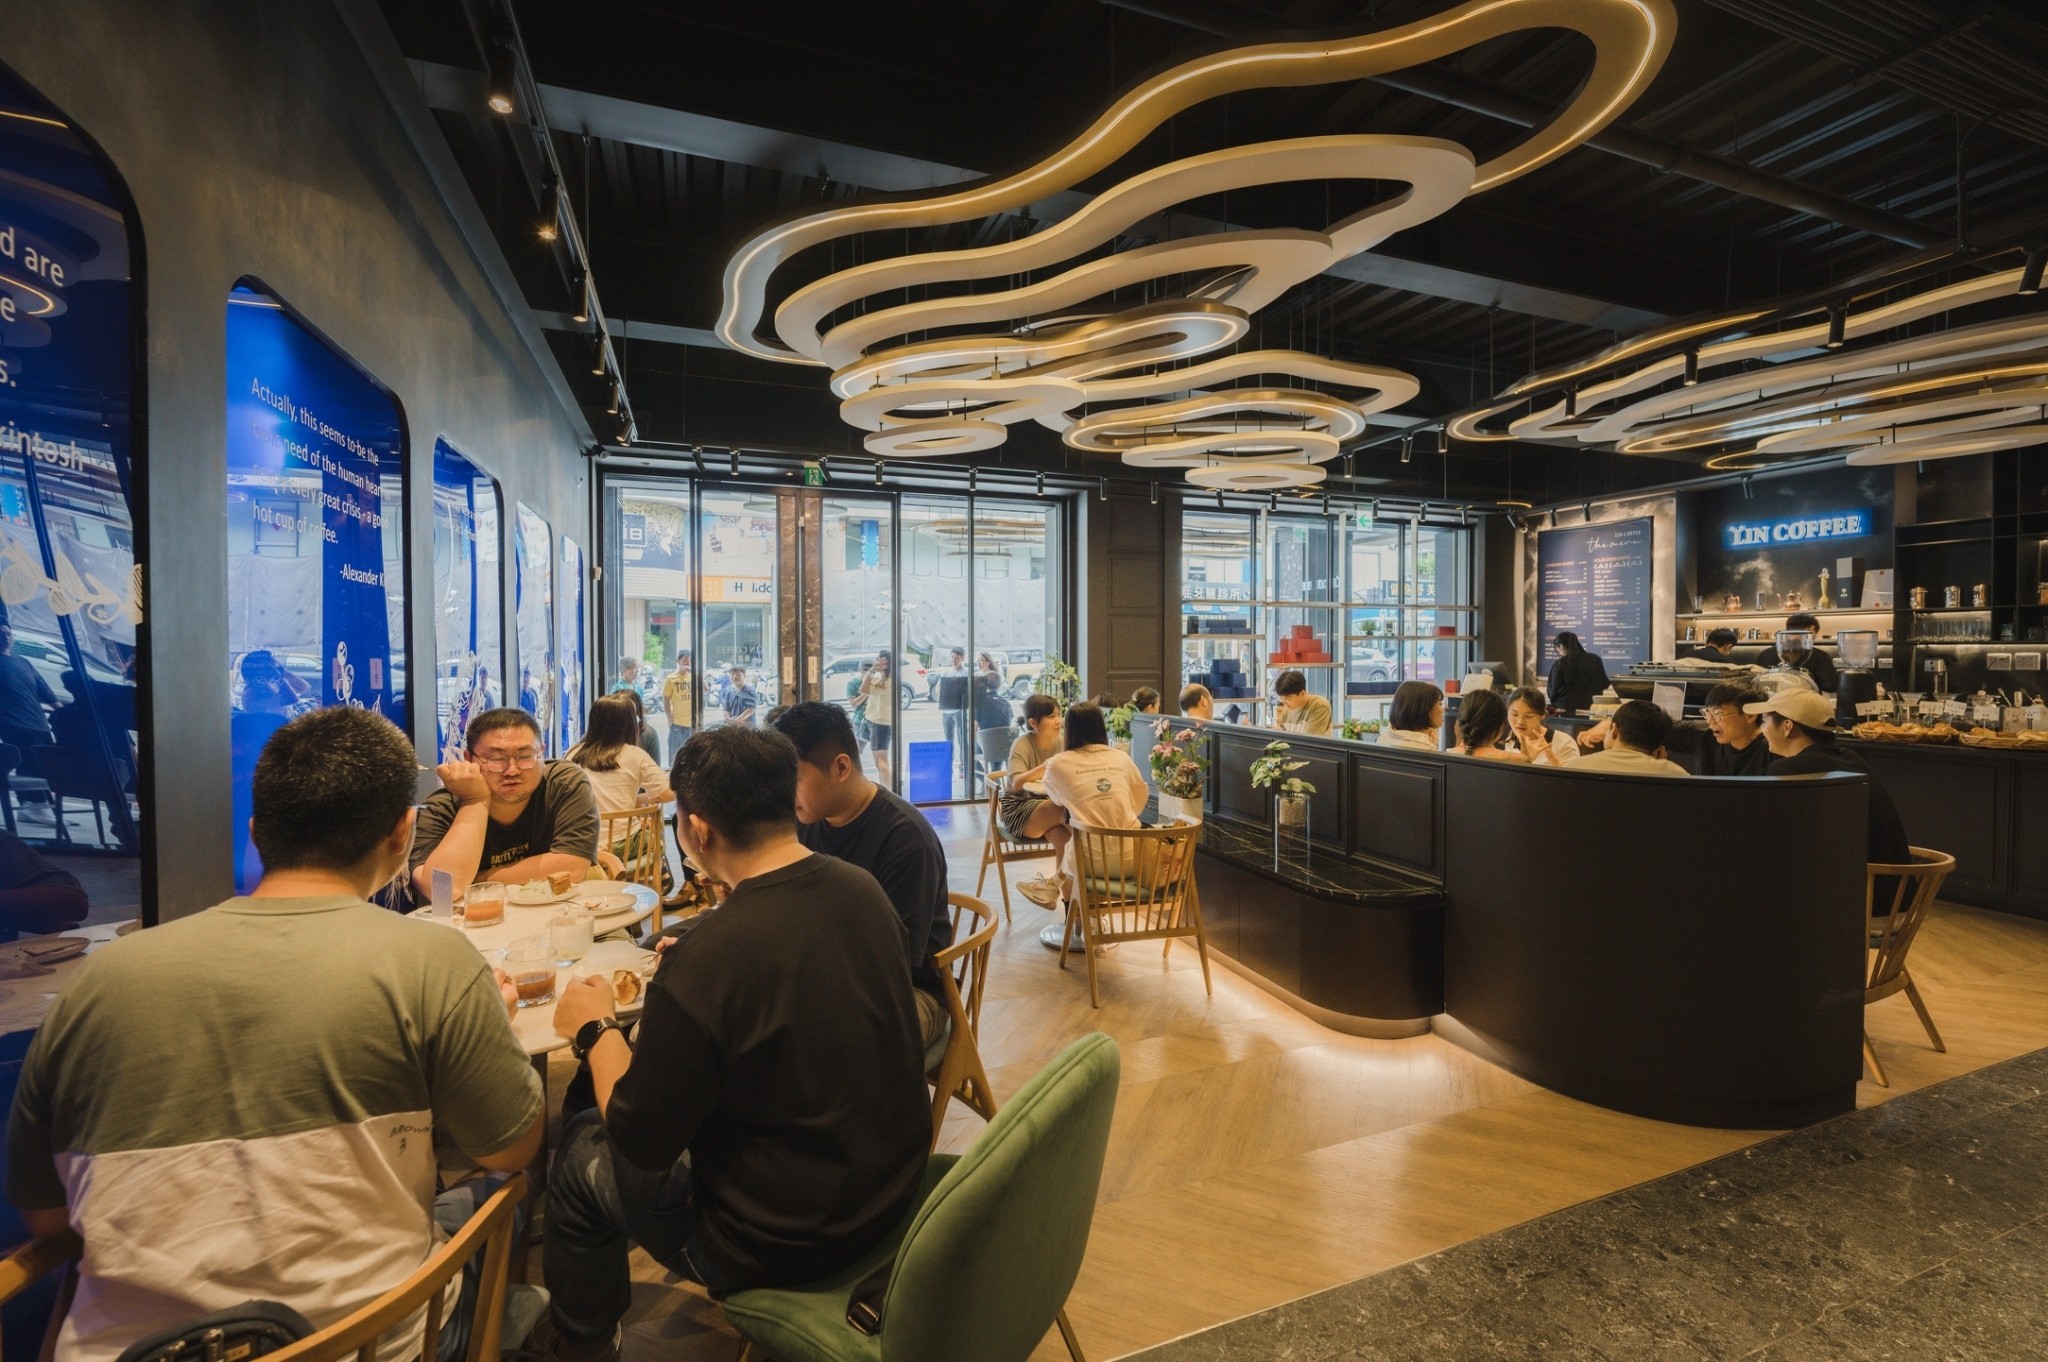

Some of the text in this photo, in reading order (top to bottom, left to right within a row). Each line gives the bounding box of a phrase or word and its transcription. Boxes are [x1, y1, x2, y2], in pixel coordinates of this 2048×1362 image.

[24, 246, 64, 287] are
[251, 377, 298, 422] Actually,
[300, 407, 318, 431] this
[319, 421, 346, 447] seems
[356, 440, 366, 459] be
[367, 448, 379, 466] the
[283, 438, 308, 462] need
[310, 450, 321, 467] of
[322, 454, 337, 475] the
[338, 461, 364, 489] human
[253, 498, 339, 544] hot cup of coffee.
[318, 491, 341, 512] great
[342, 499, 361, 519] crisis
[1586, 536, 1608, 553] the
[1729, 515, 1861, 545] YIN COFFEE
[339, 563, 378, 586] -Alexander
